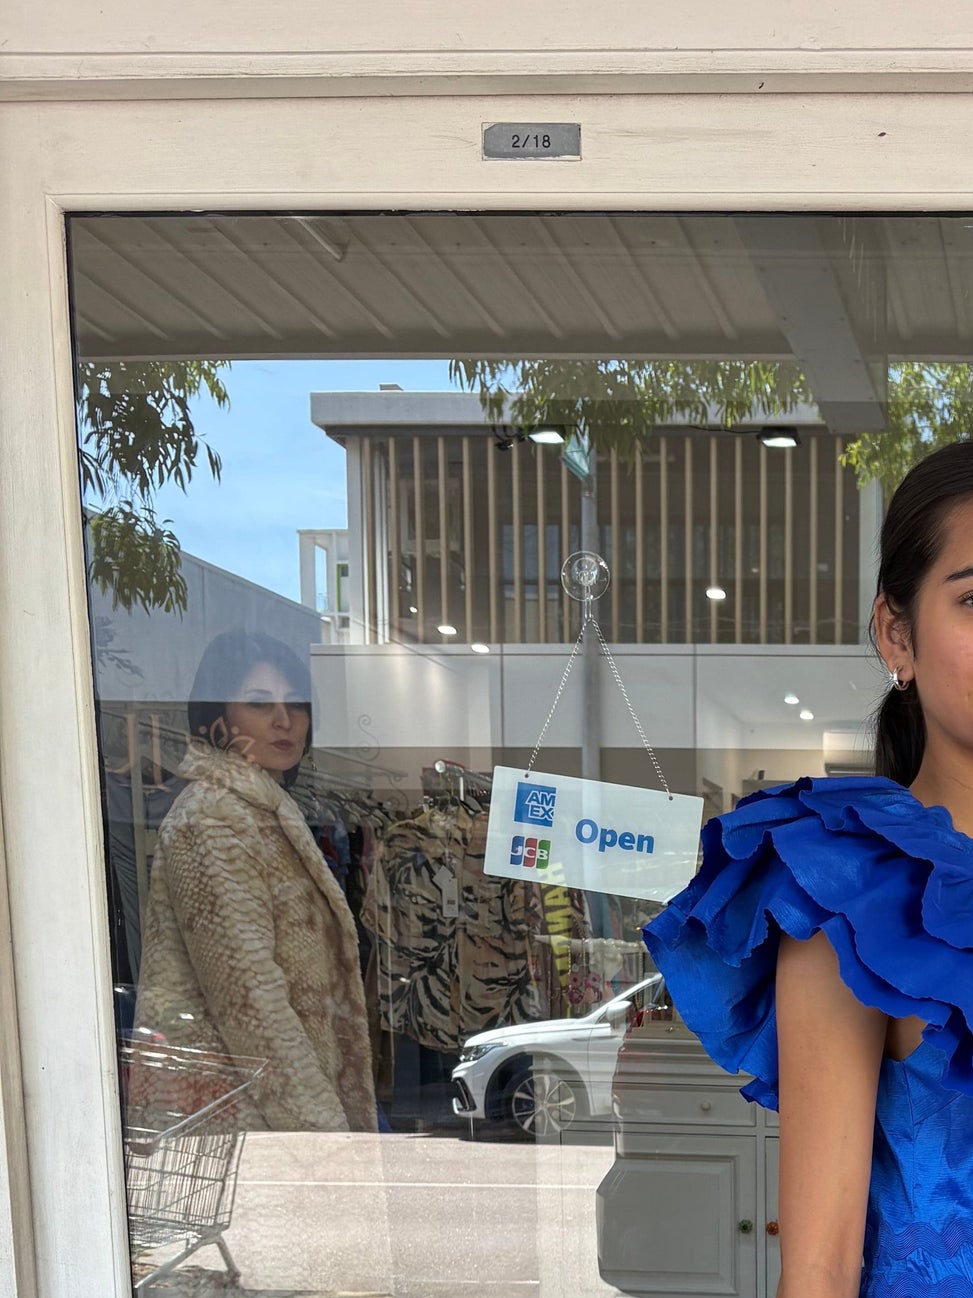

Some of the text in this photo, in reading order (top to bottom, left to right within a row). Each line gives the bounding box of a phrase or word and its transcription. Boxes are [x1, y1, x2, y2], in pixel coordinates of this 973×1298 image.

[511, 134, 551, 149] 2/18
[575, 818, 655, 854] Open
[510, 842, 550, 864] JCB
